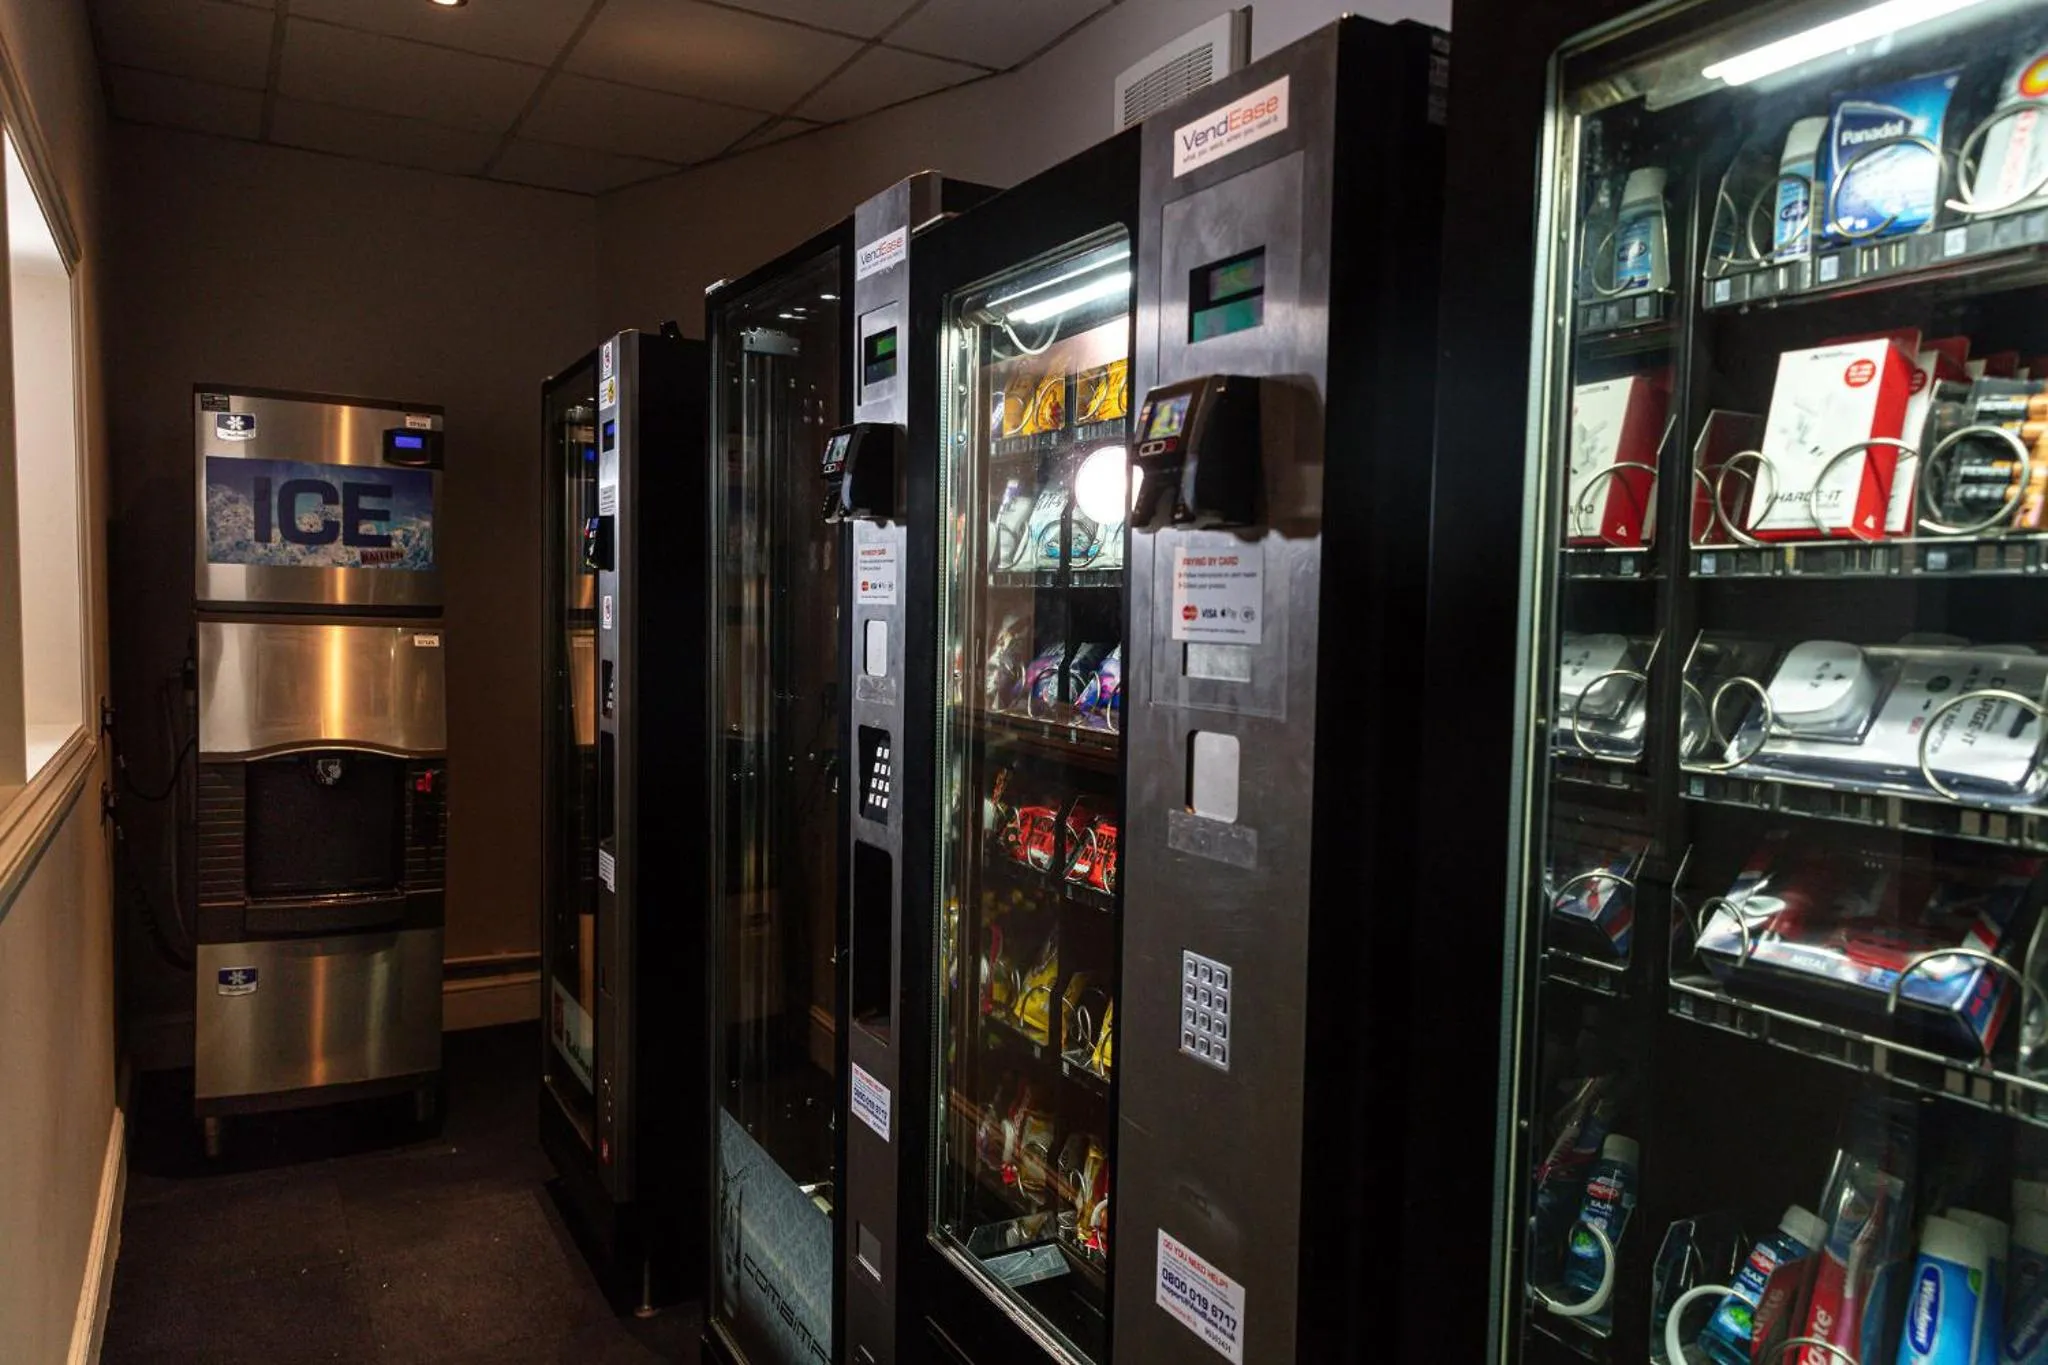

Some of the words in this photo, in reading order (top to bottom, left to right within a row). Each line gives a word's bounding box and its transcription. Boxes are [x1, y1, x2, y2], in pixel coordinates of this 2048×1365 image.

[1183, 95, 1279, 151] VendEase
[1840, 119, 1905, 146] Panadol
[861, 237, 903, 265] VendEase
[253, 476, 392, 547] ICE
[1207, 556, 1217, 566] BY
[1219, 555, 1239, 566] CARD
[1174, 1246, 1187, 1261] YOU
[1188, 1256, 1206, 1275] NEED
[1162, 1267, 1187, 1294] 0800
[1189, 1288, 1208, 1310] 019
[1211, 1304, 1237, 1331] 6717
